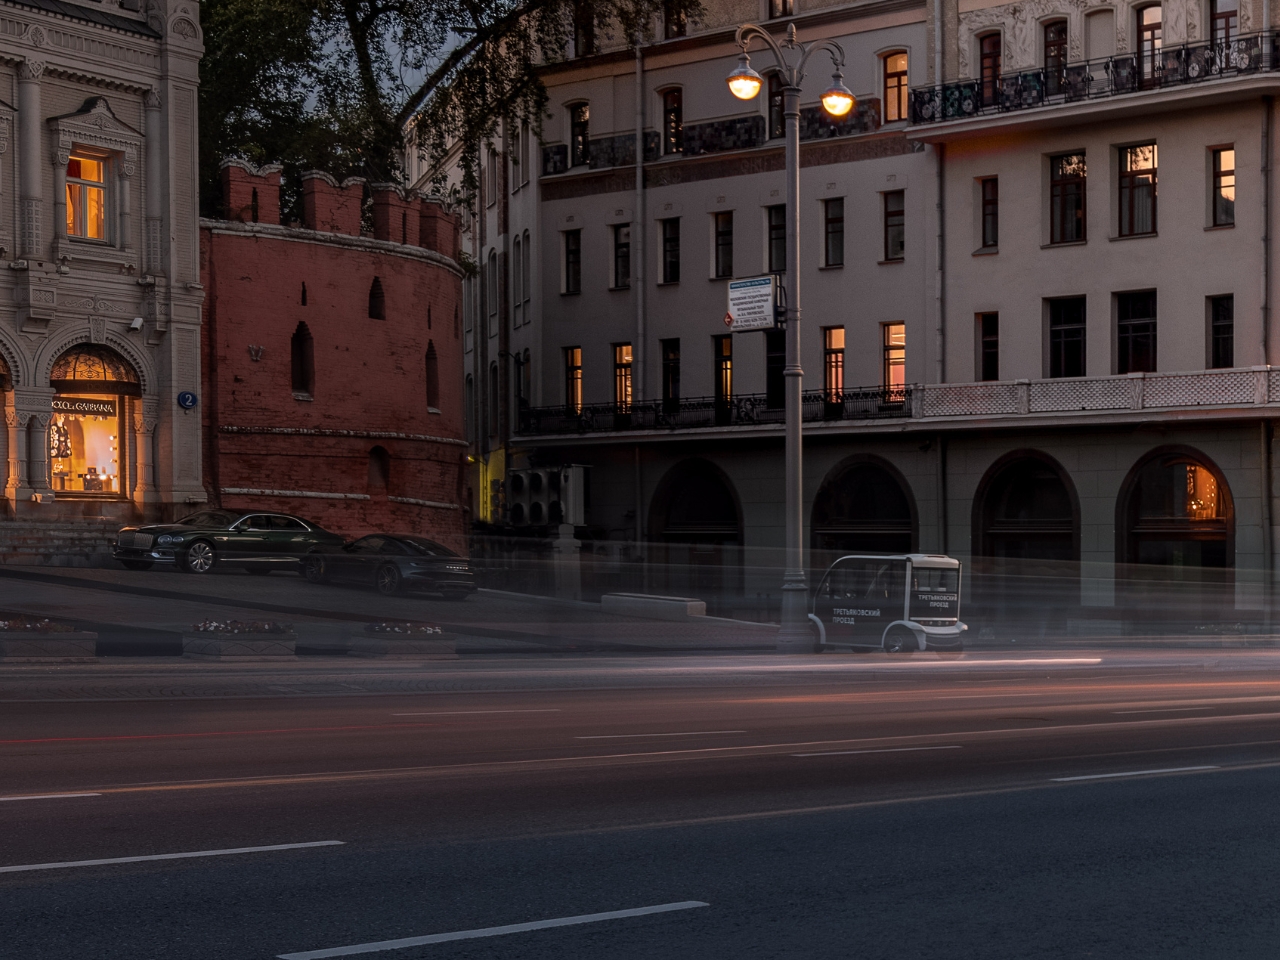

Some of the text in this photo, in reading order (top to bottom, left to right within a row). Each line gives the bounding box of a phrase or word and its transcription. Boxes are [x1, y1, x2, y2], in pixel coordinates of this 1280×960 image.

[185, 394, 193, 406] 2
[833, 608, 881, 617] ТРЕТЬЯКОВСКИЙ
[833, 617, 855, 625] ПРОЕЗД
